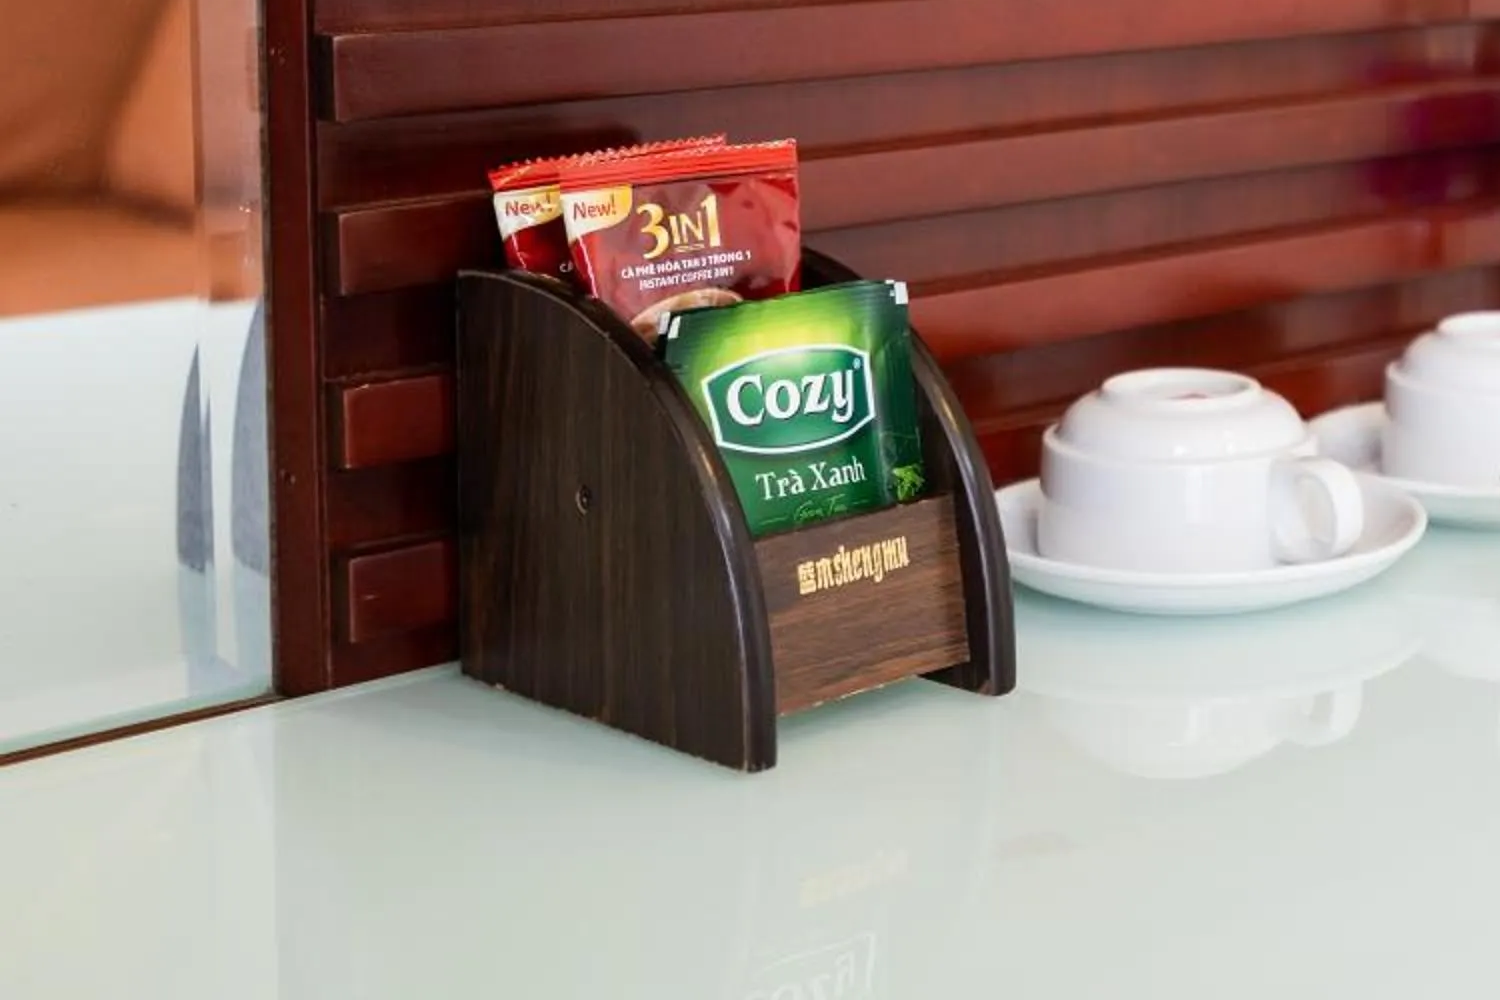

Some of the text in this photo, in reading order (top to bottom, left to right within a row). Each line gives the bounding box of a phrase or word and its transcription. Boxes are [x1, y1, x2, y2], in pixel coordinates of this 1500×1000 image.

[573, 193, 617, 221] New!
[708, 250, 744, 266] TRONG
[639, 273, 682, 291] INSTANT
[726, 369, 854, 426] Cozy
[755, 455, 867, 500] Trà Xanh
